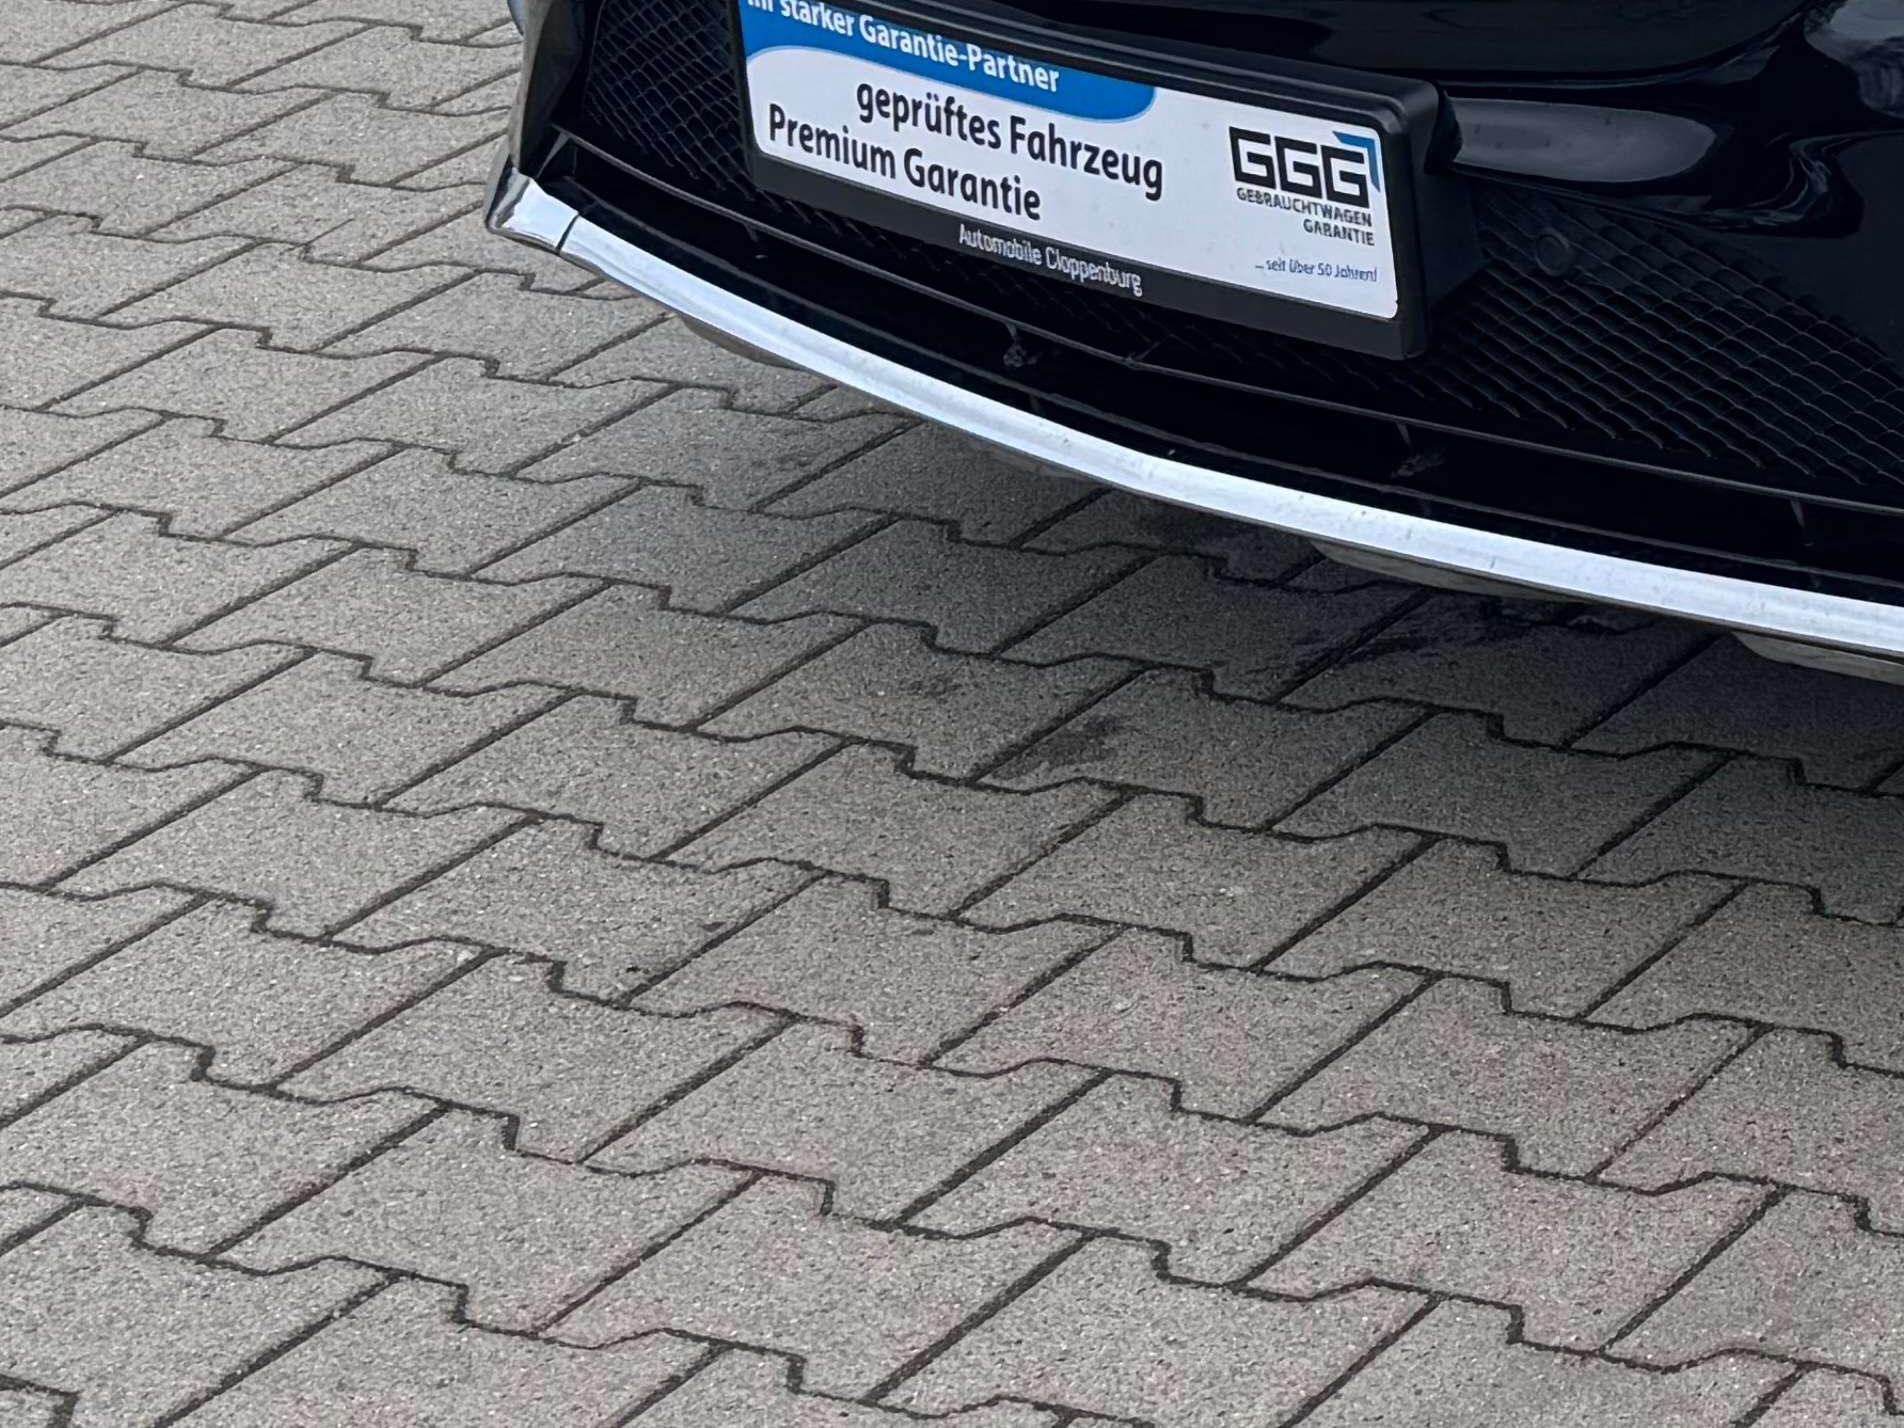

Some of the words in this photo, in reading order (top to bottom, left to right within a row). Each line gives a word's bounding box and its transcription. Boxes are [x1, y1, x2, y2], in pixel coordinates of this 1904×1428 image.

[858, 13, 1060, 93] Garantie-Partner
[769, 103, 896, 180] Premium
[903, 147, 1041, 221] Garantie
[856, 82, 1001, 149] geprüftes
[1009, 115, 1163, 202] Fahrzeug
[1228, 126, 1371, 210] GGG
[1236, 187, 1373, 228] GEBRAUCHTWAGEN
[1303, 218, 1376, 247] GARANTIE
[958, 223, 1043, 266] Automobile
[1045, 246, 1143, 297] Cloppenburg
